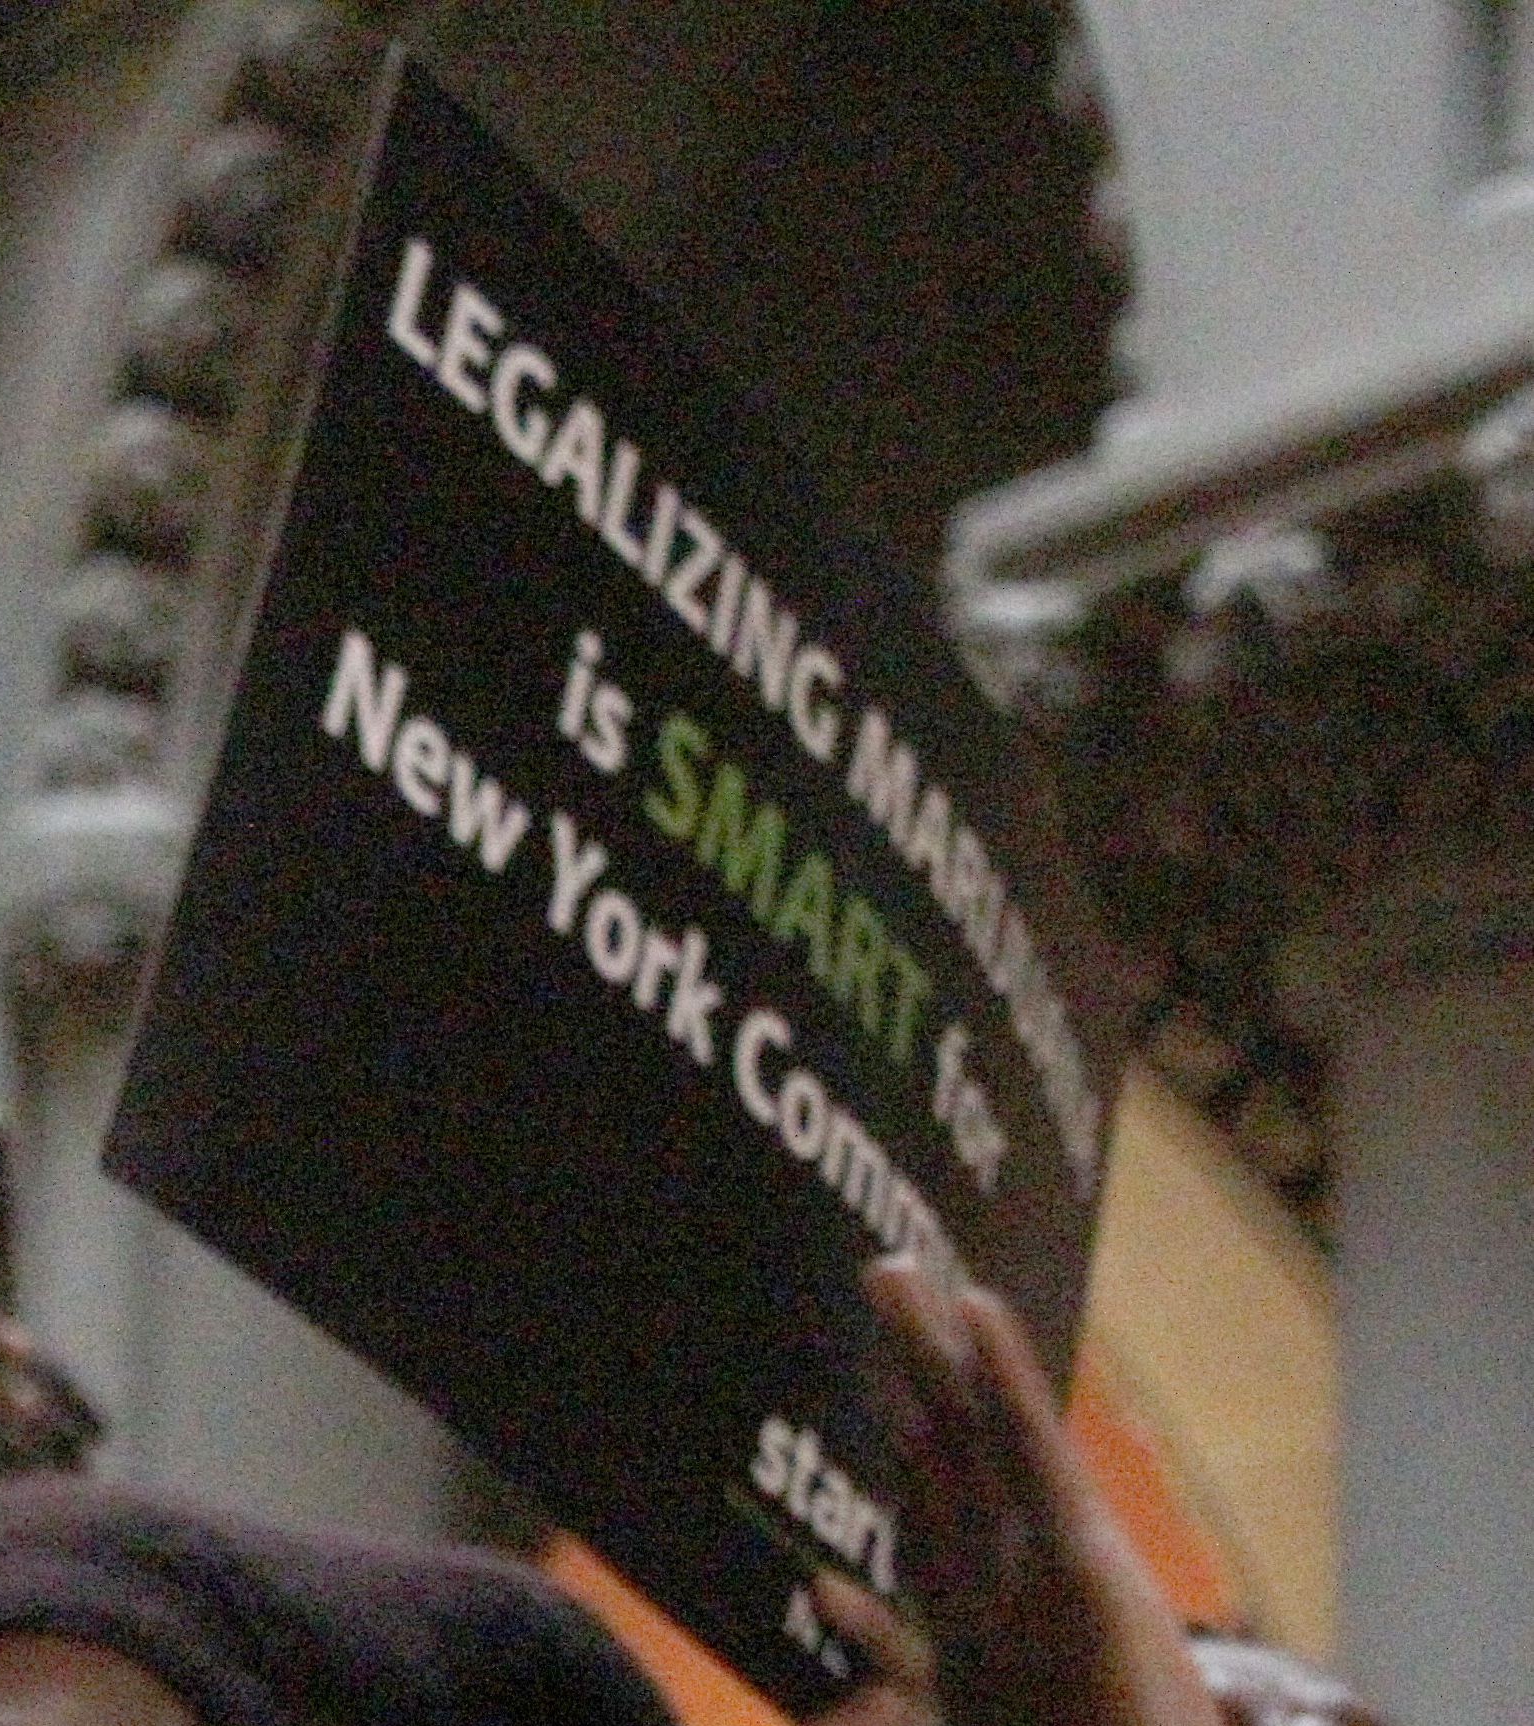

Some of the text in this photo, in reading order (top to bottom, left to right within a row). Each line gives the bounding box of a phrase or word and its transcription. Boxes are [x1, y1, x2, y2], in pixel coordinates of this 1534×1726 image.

[387, 237, 843, 763] LEGALIZING
[322, 630, 531, 873] New
[547, 811, 723, 1068] York
[558, 631, 634, 775] is
[643, 713, 928, 1065] SMART
